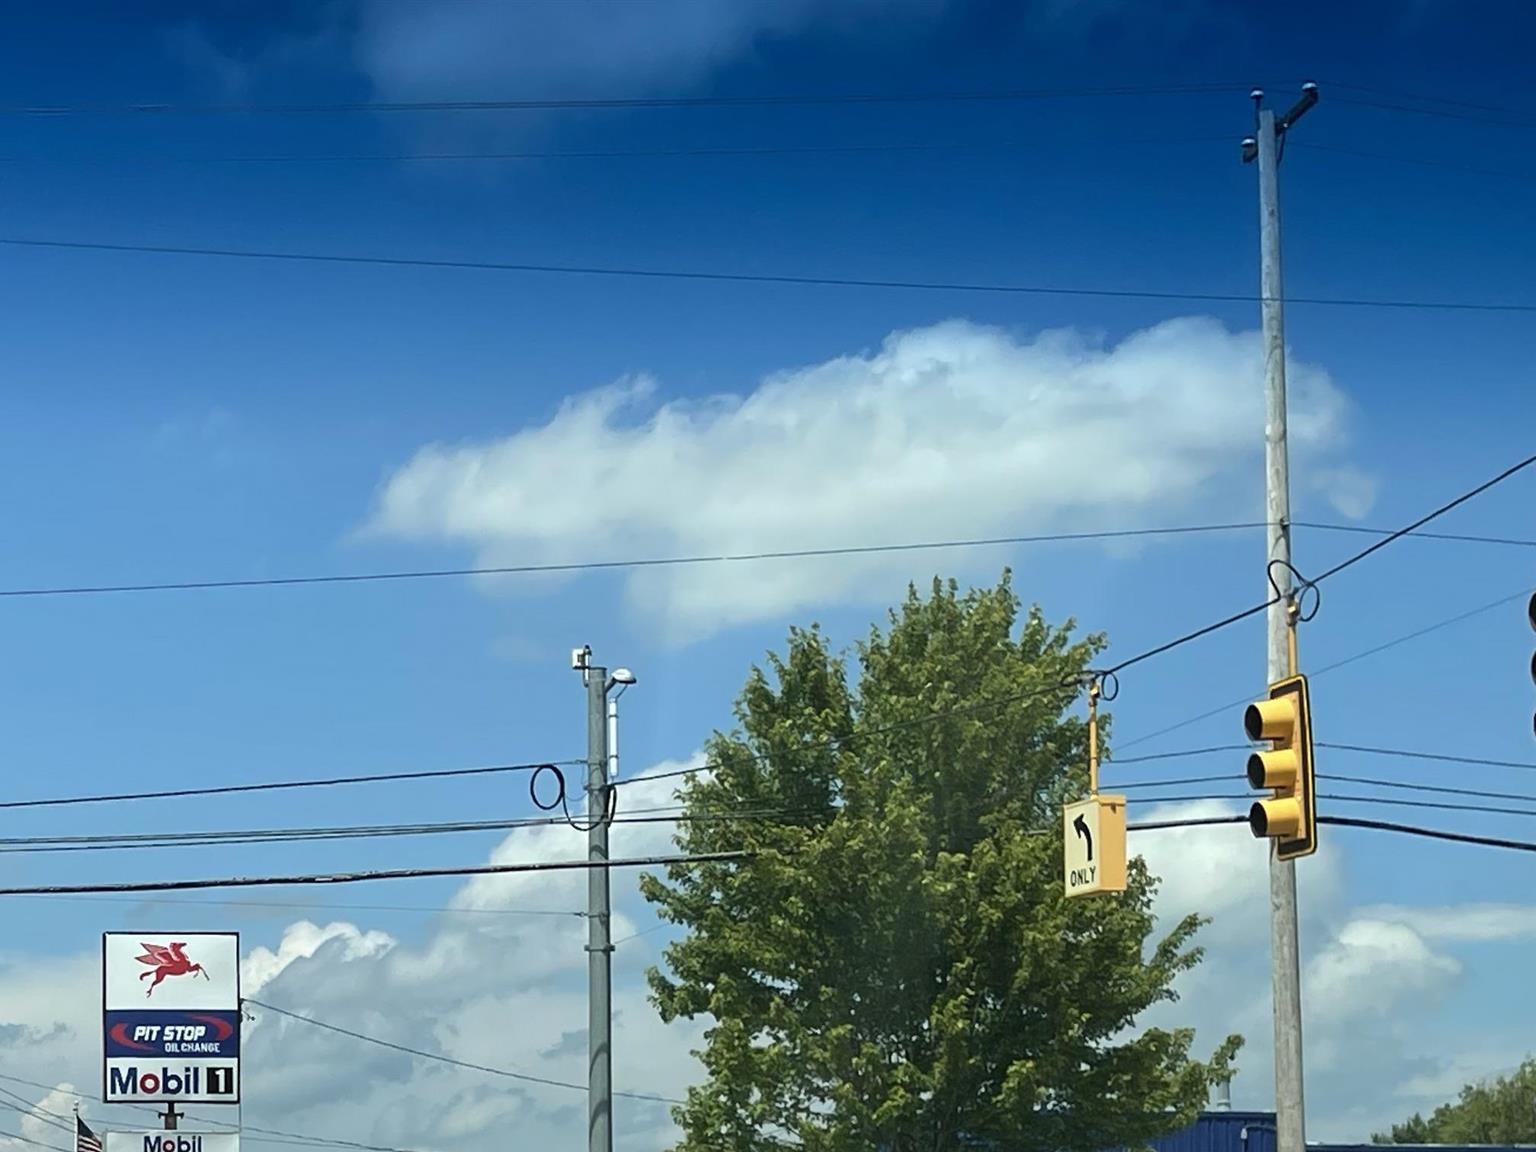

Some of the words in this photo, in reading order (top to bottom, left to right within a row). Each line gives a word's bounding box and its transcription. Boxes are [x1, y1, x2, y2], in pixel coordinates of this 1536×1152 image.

[1070, 866, 1096, 887] ONLY
[134, 1025, 160, 1041] PIT
[164, 1025, 206, 1041] STOP
[164, 1042, 180, 1053] OIL
[181, 1042, 220, 1053] CHANGE
[110, 1066, 199, 1095] Mobil
